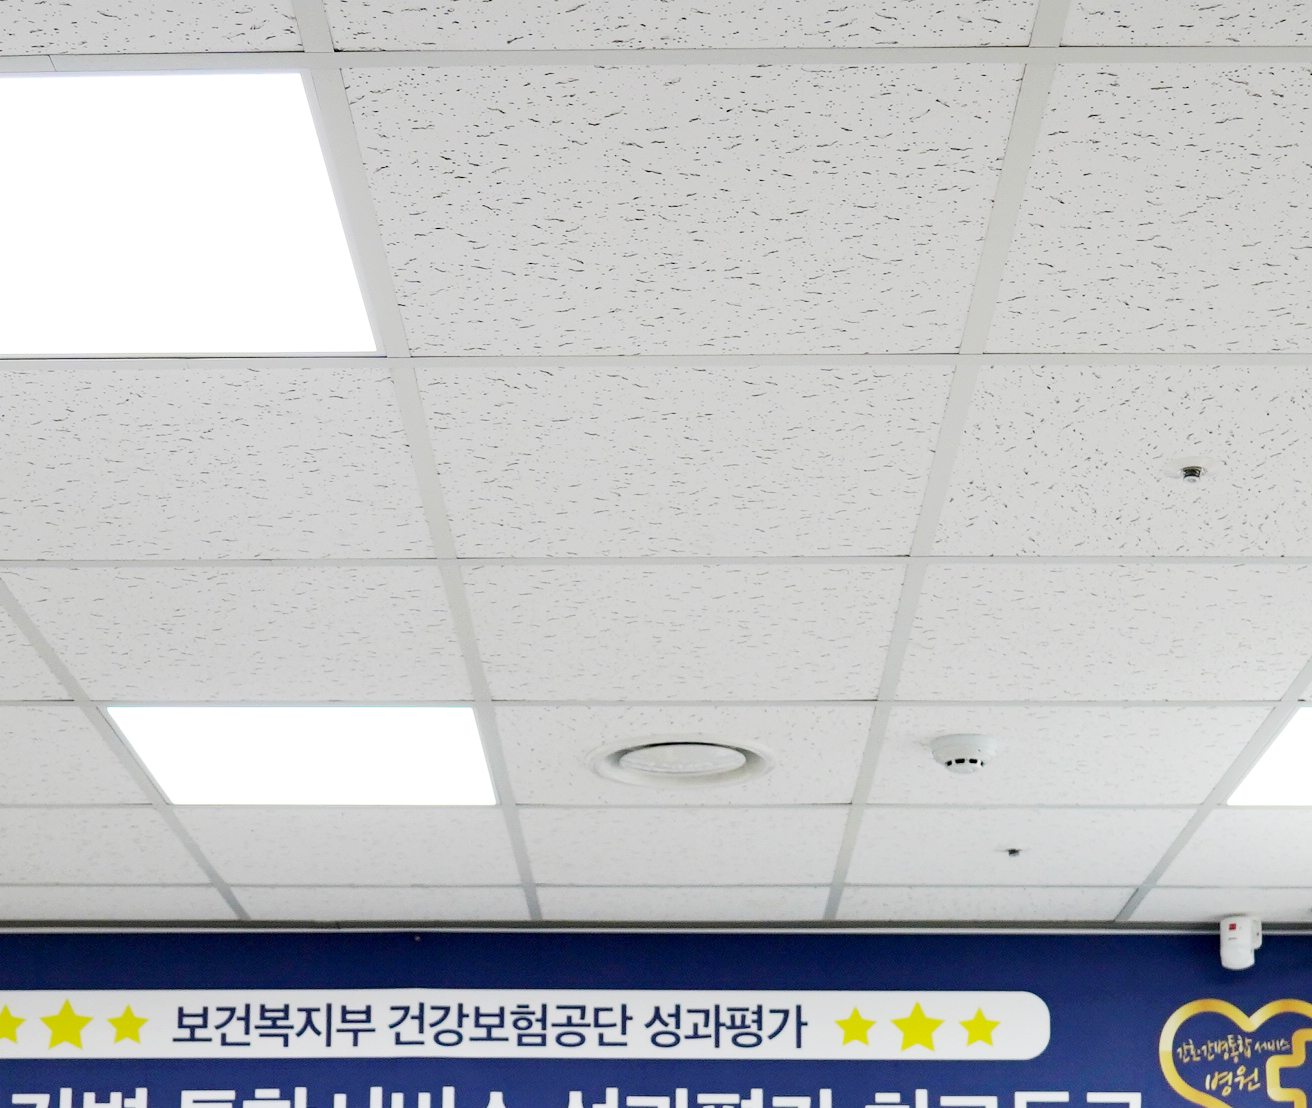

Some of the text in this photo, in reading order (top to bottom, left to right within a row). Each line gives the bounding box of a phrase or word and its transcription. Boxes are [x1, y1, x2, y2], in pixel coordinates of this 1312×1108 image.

[171, 1002, 808, 1050] 보건복지부 건강보험공단 성과평가
[1205, 1065, 1261, 1097] 병원
